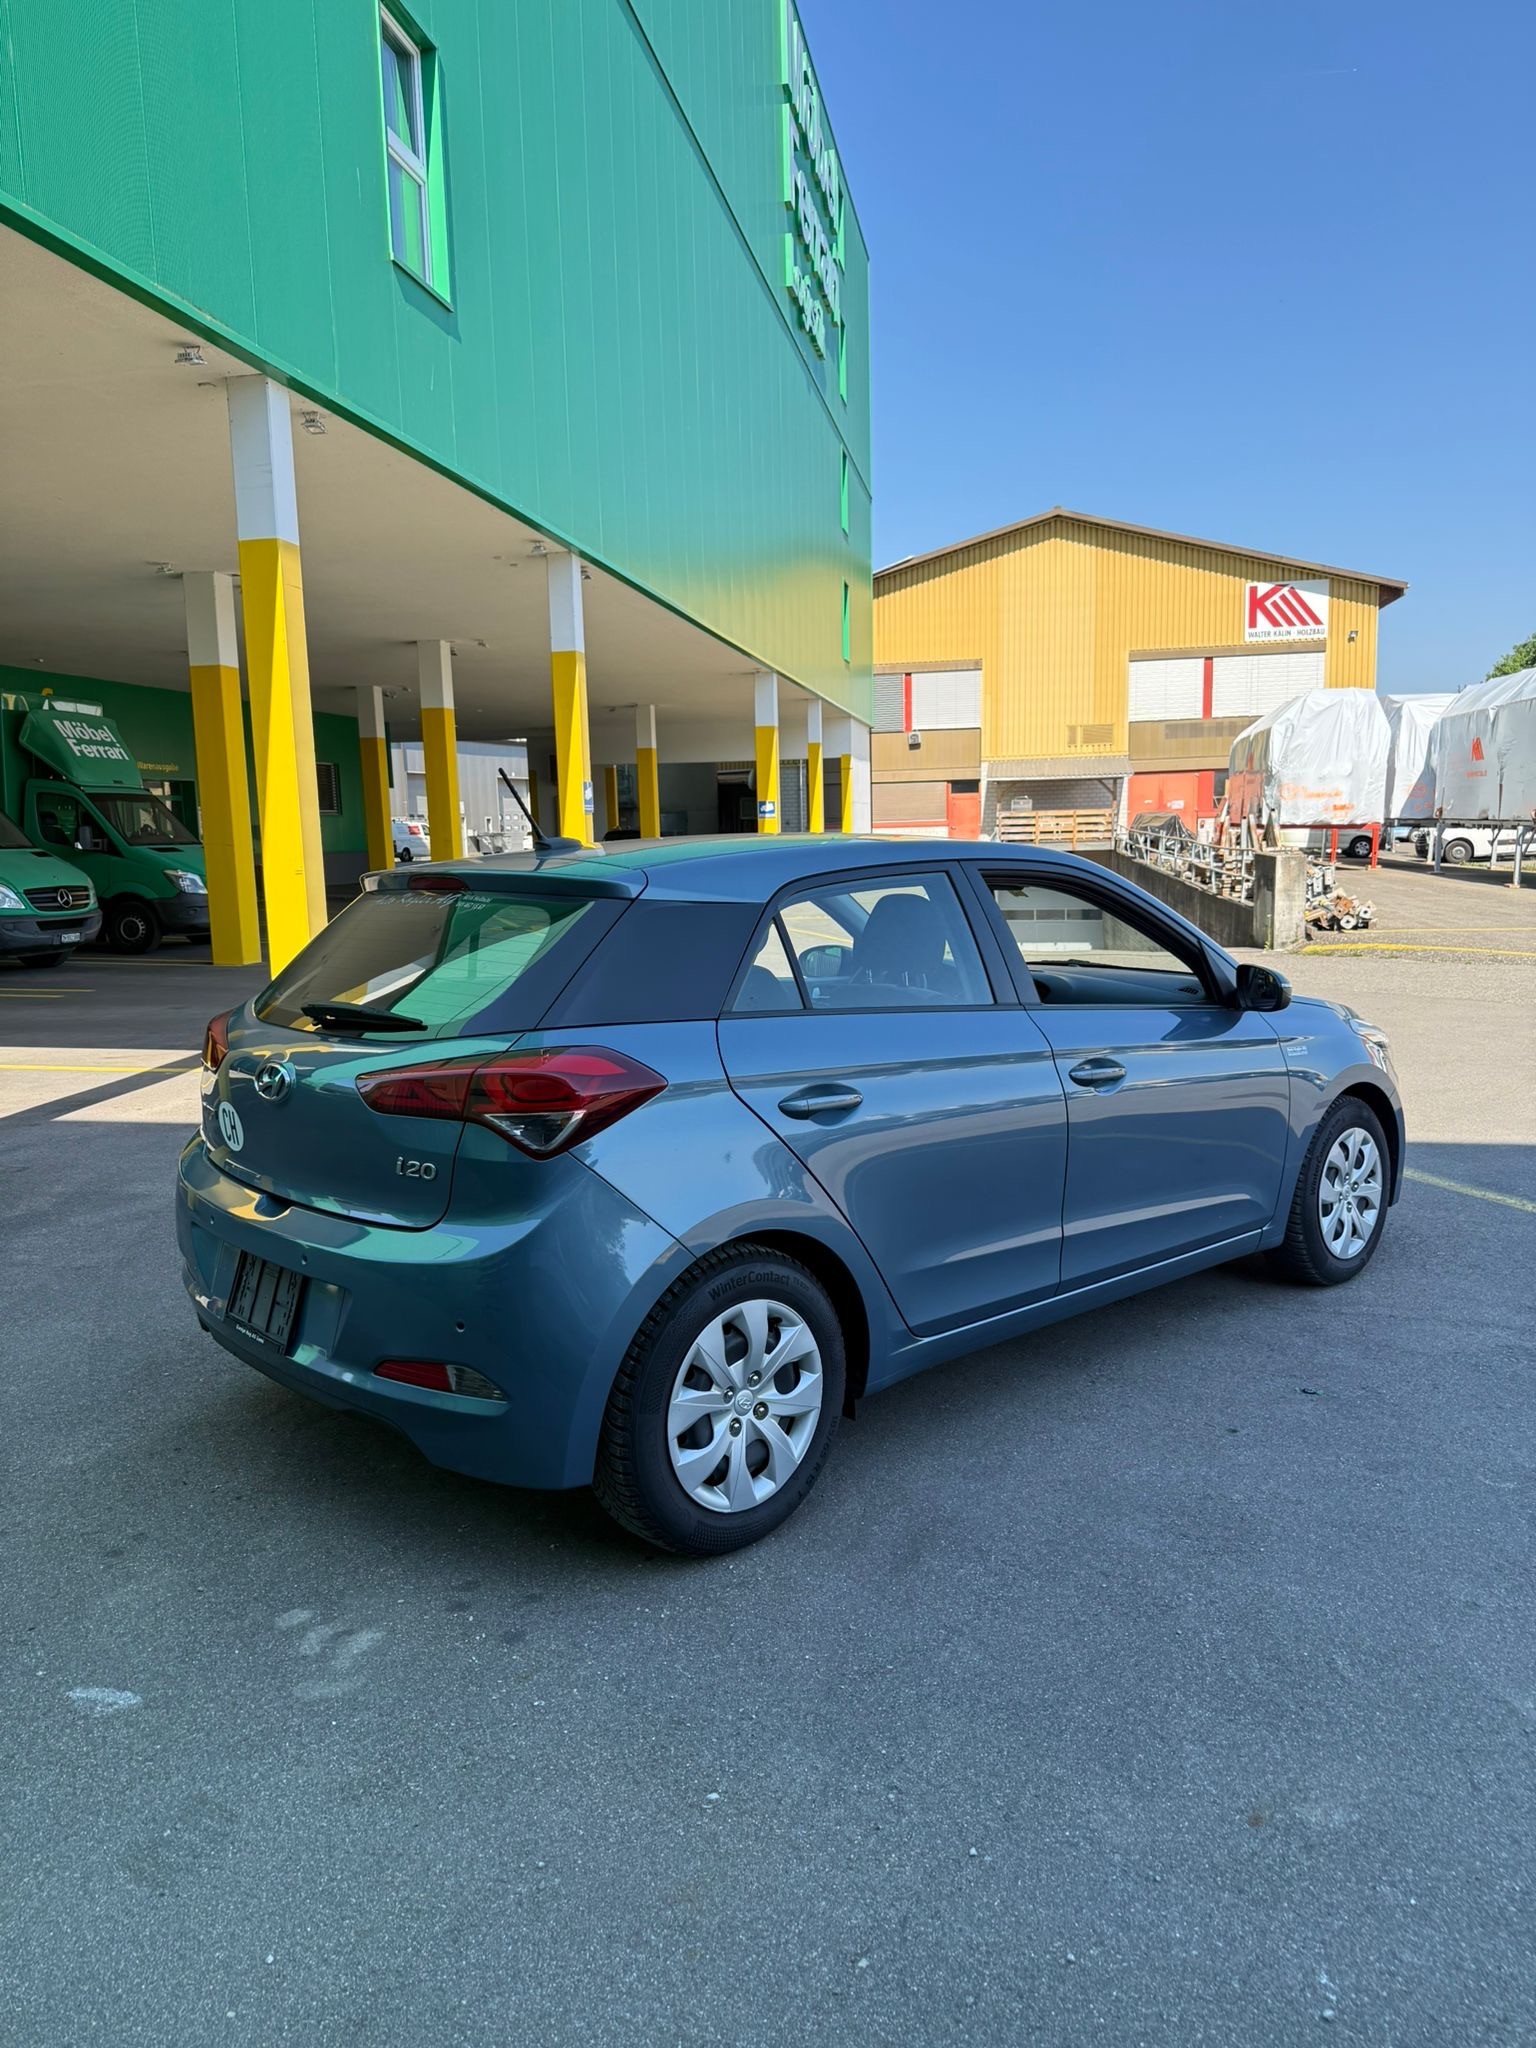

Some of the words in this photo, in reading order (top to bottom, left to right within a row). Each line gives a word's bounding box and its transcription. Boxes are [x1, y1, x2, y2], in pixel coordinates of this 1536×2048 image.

[783, 103, 840, 327] Ferrari
[1248, 631, 1271, 639] WALTER
[1297, 628, 1325, 636] HOLZBAU
[53, 719, 117, 742] Möbel
[66, 738, 130, 761] Ferrari
[221, 1106, 240, 1146] CH
[395, 1156, 438, 1181] i20
[707, 1270, 791, 1301] WinterContact
